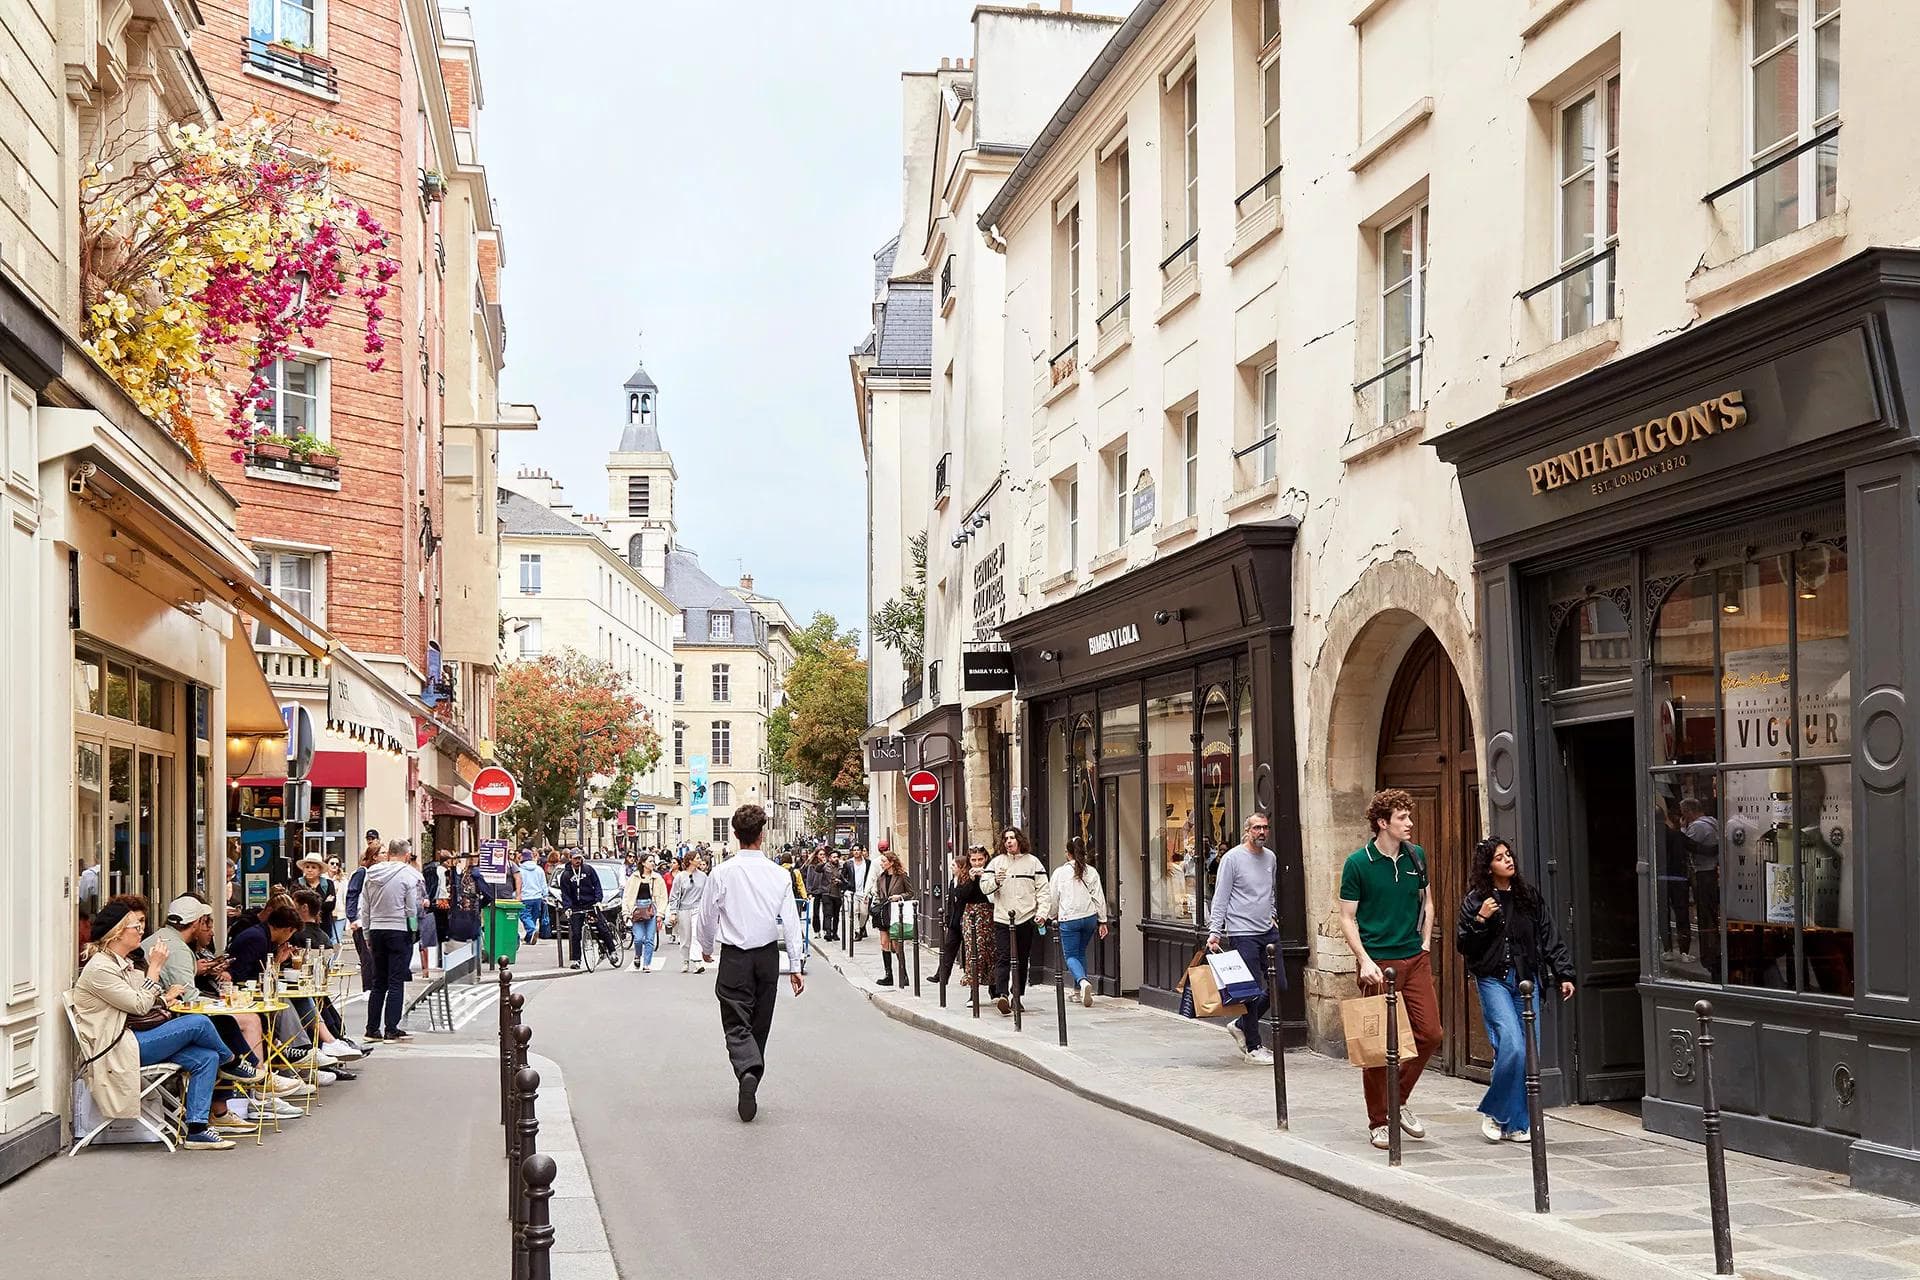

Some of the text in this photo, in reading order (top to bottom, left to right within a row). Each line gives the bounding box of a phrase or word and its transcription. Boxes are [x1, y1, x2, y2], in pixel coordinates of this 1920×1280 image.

[1526, 389, 1748, 496] PENHALIGON'S
[1591, 455, 1687, 495] EST. LONDON 1870
[1088, 623, 1140, 656] BIMBA Y LOLA
[250, 845, 265, 866] P
